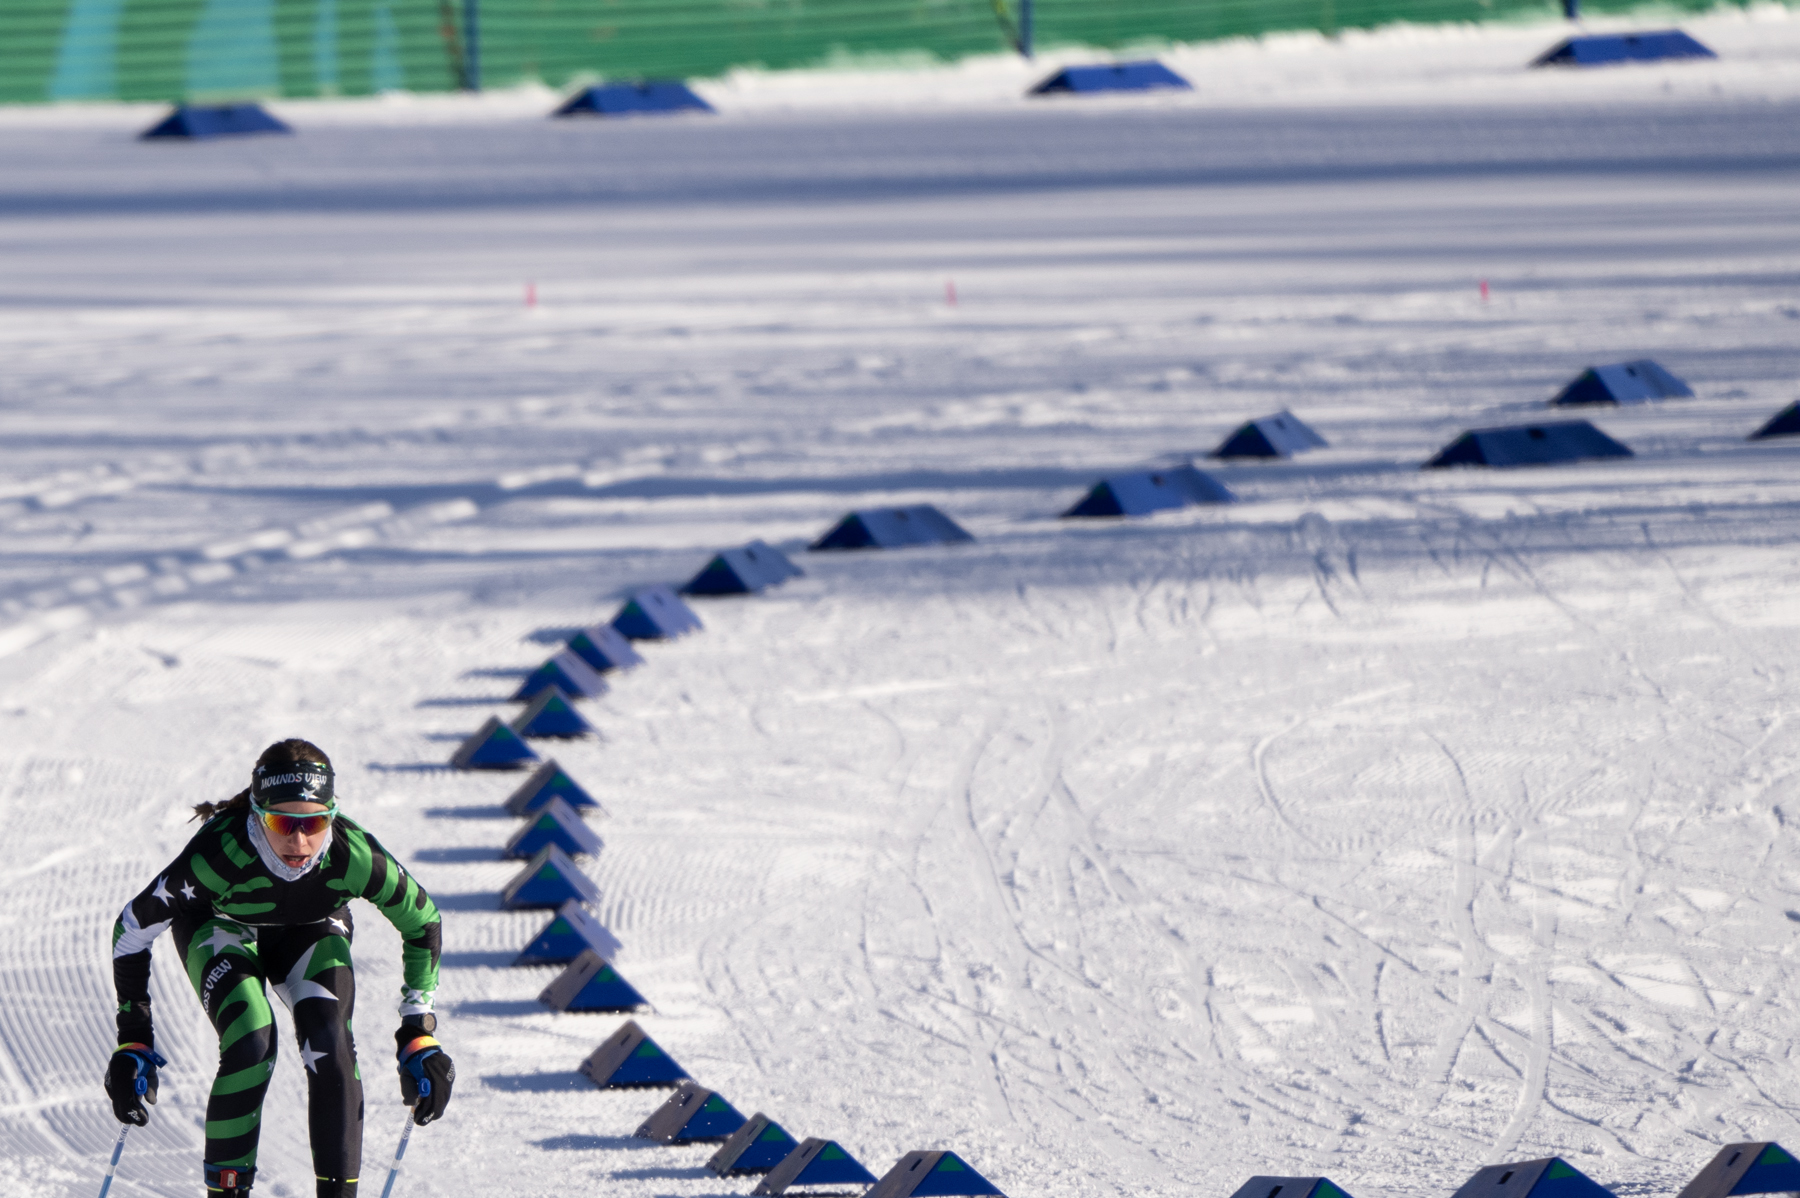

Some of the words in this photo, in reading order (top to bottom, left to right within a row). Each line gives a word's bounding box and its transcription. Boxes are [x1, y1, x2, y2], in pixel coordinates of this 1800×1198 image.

[261, 772, 303, 789] MOUNDS
[304, 773, 327, 785] VIEW
[205, 959, 232, 989] VIEW
